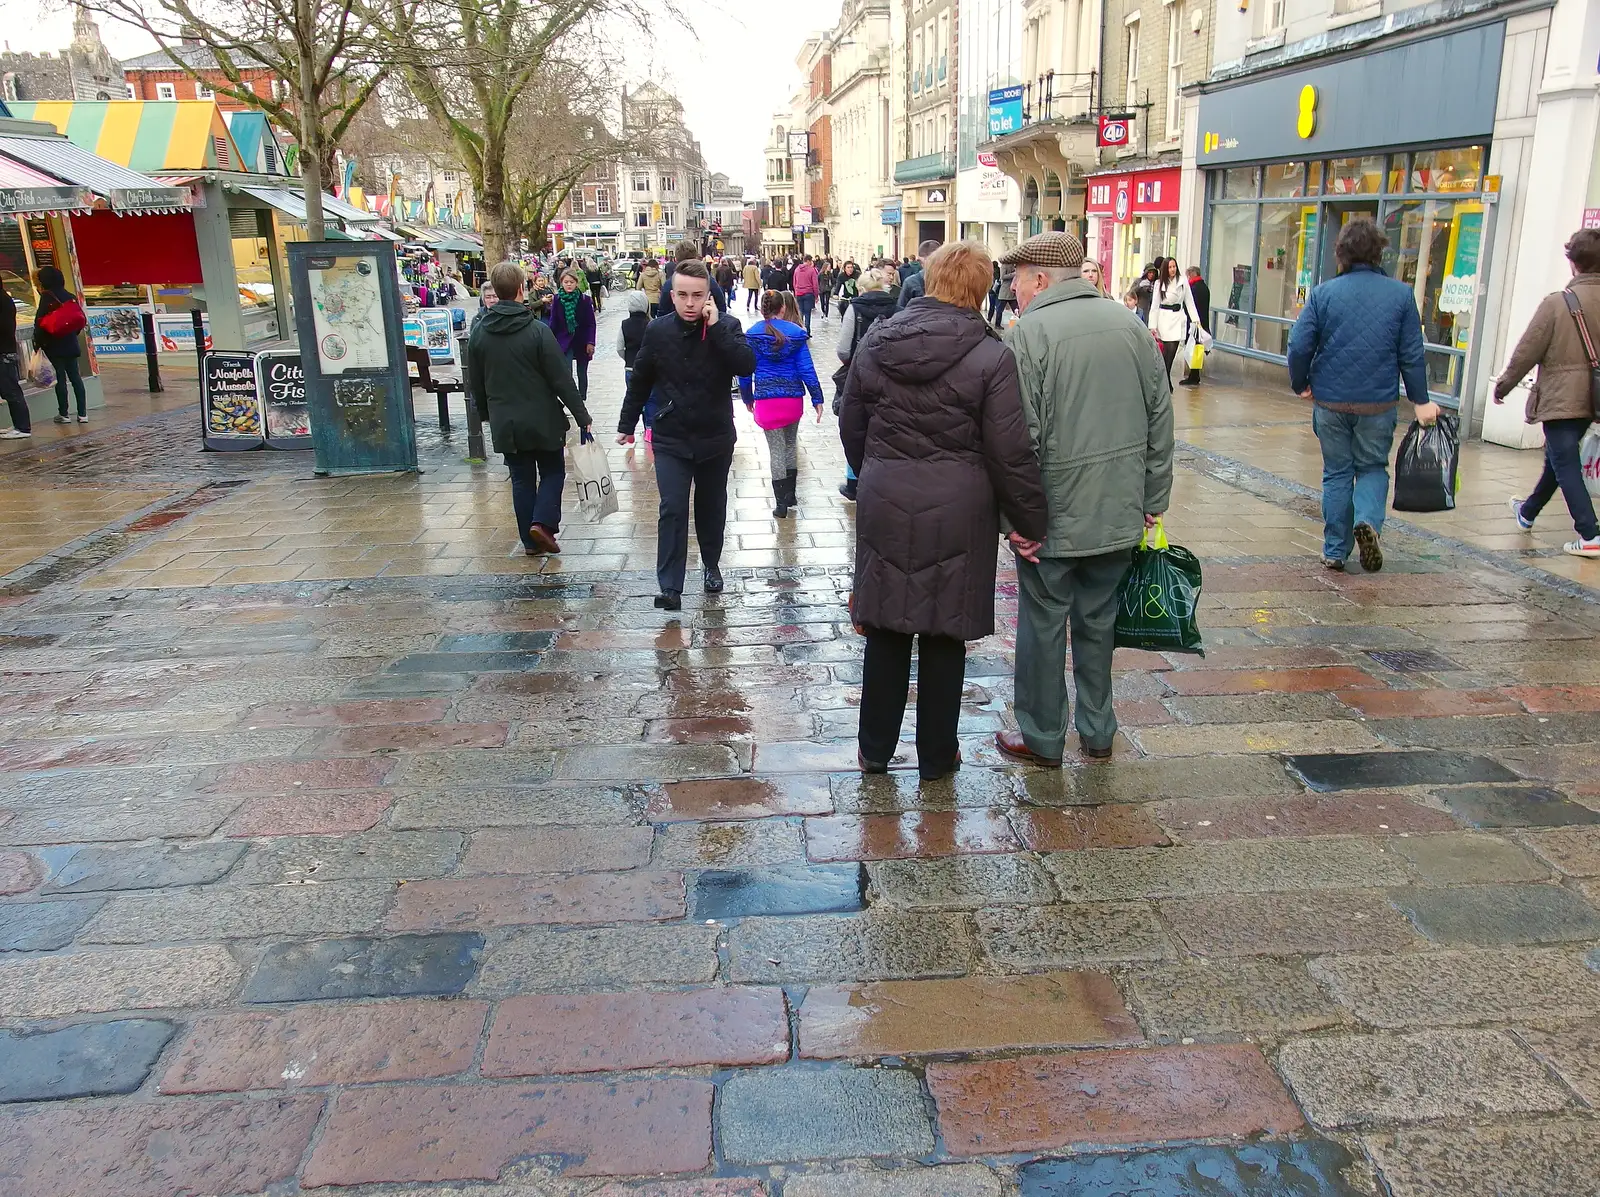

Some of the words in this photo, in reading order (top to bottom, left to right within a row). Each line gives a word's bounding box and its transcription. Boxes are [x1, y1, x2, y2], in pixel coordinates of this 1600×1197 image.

[991, 119, 1000, 131] to
[1001, 115, 1013, 130] let
[0, 191, 17, 210] City
[14, 190, 36, 206] Fish
[126, 190, 141, 206] City
[139, 189, 153, 203] Fish
[1445, 284, 1457, 295] NO
[209, 368, 254, 381] Norfolk
[210, 380, 256, 392] Mussels
